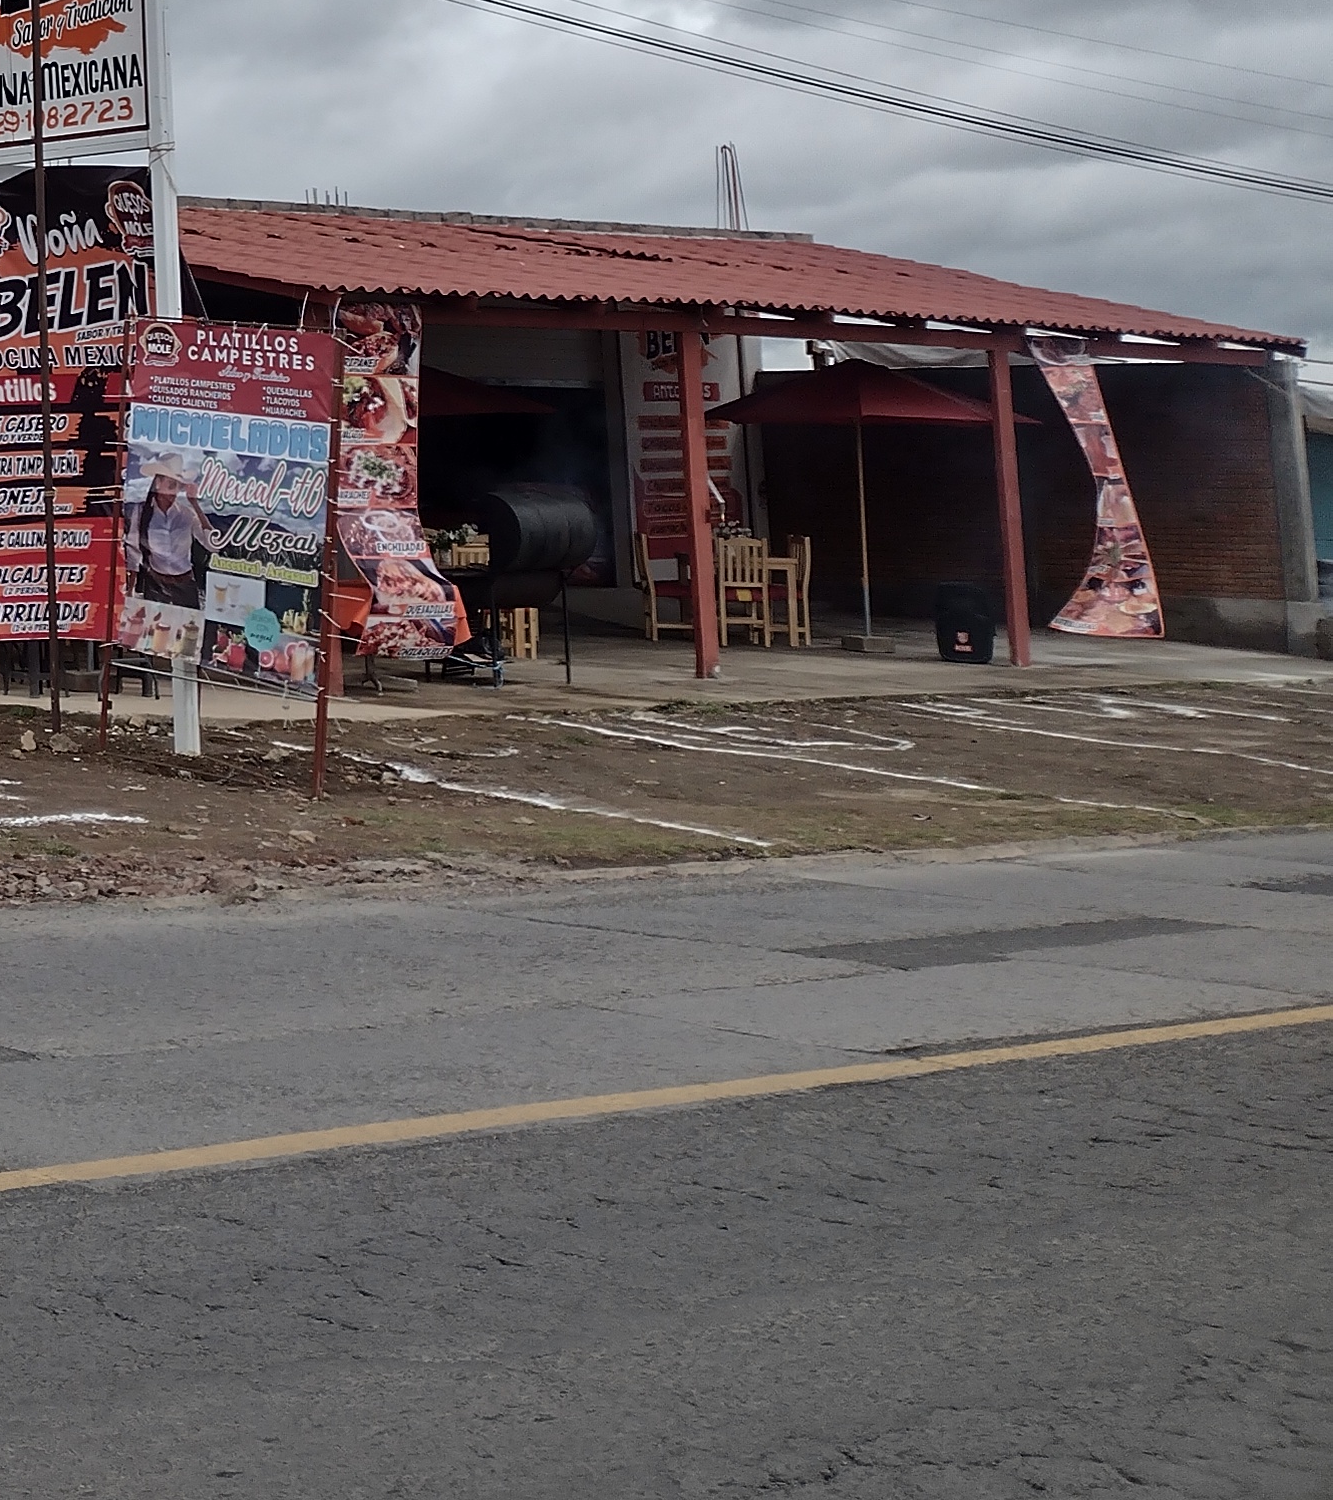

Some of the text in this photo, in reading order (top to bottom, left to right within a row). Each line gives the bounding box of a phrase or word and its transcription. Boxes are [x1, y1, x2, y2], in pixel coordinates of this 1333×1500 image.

[13, 17, 52, 47] Saor
[148, 343, 172, 354] MOLE
[197, 329, 299, 353] PLATILLOS
[188, 345, 315, 371] CAMPESTRES
[132, 405, 329, 462] MICHELADAS
[60, 530, 90, 547] POLLO
[209, 516, 318, 553] Mezcal
[377, 541, 425, 552] ENCHILADAS
[211, 553, 261, 574] Ancestral
